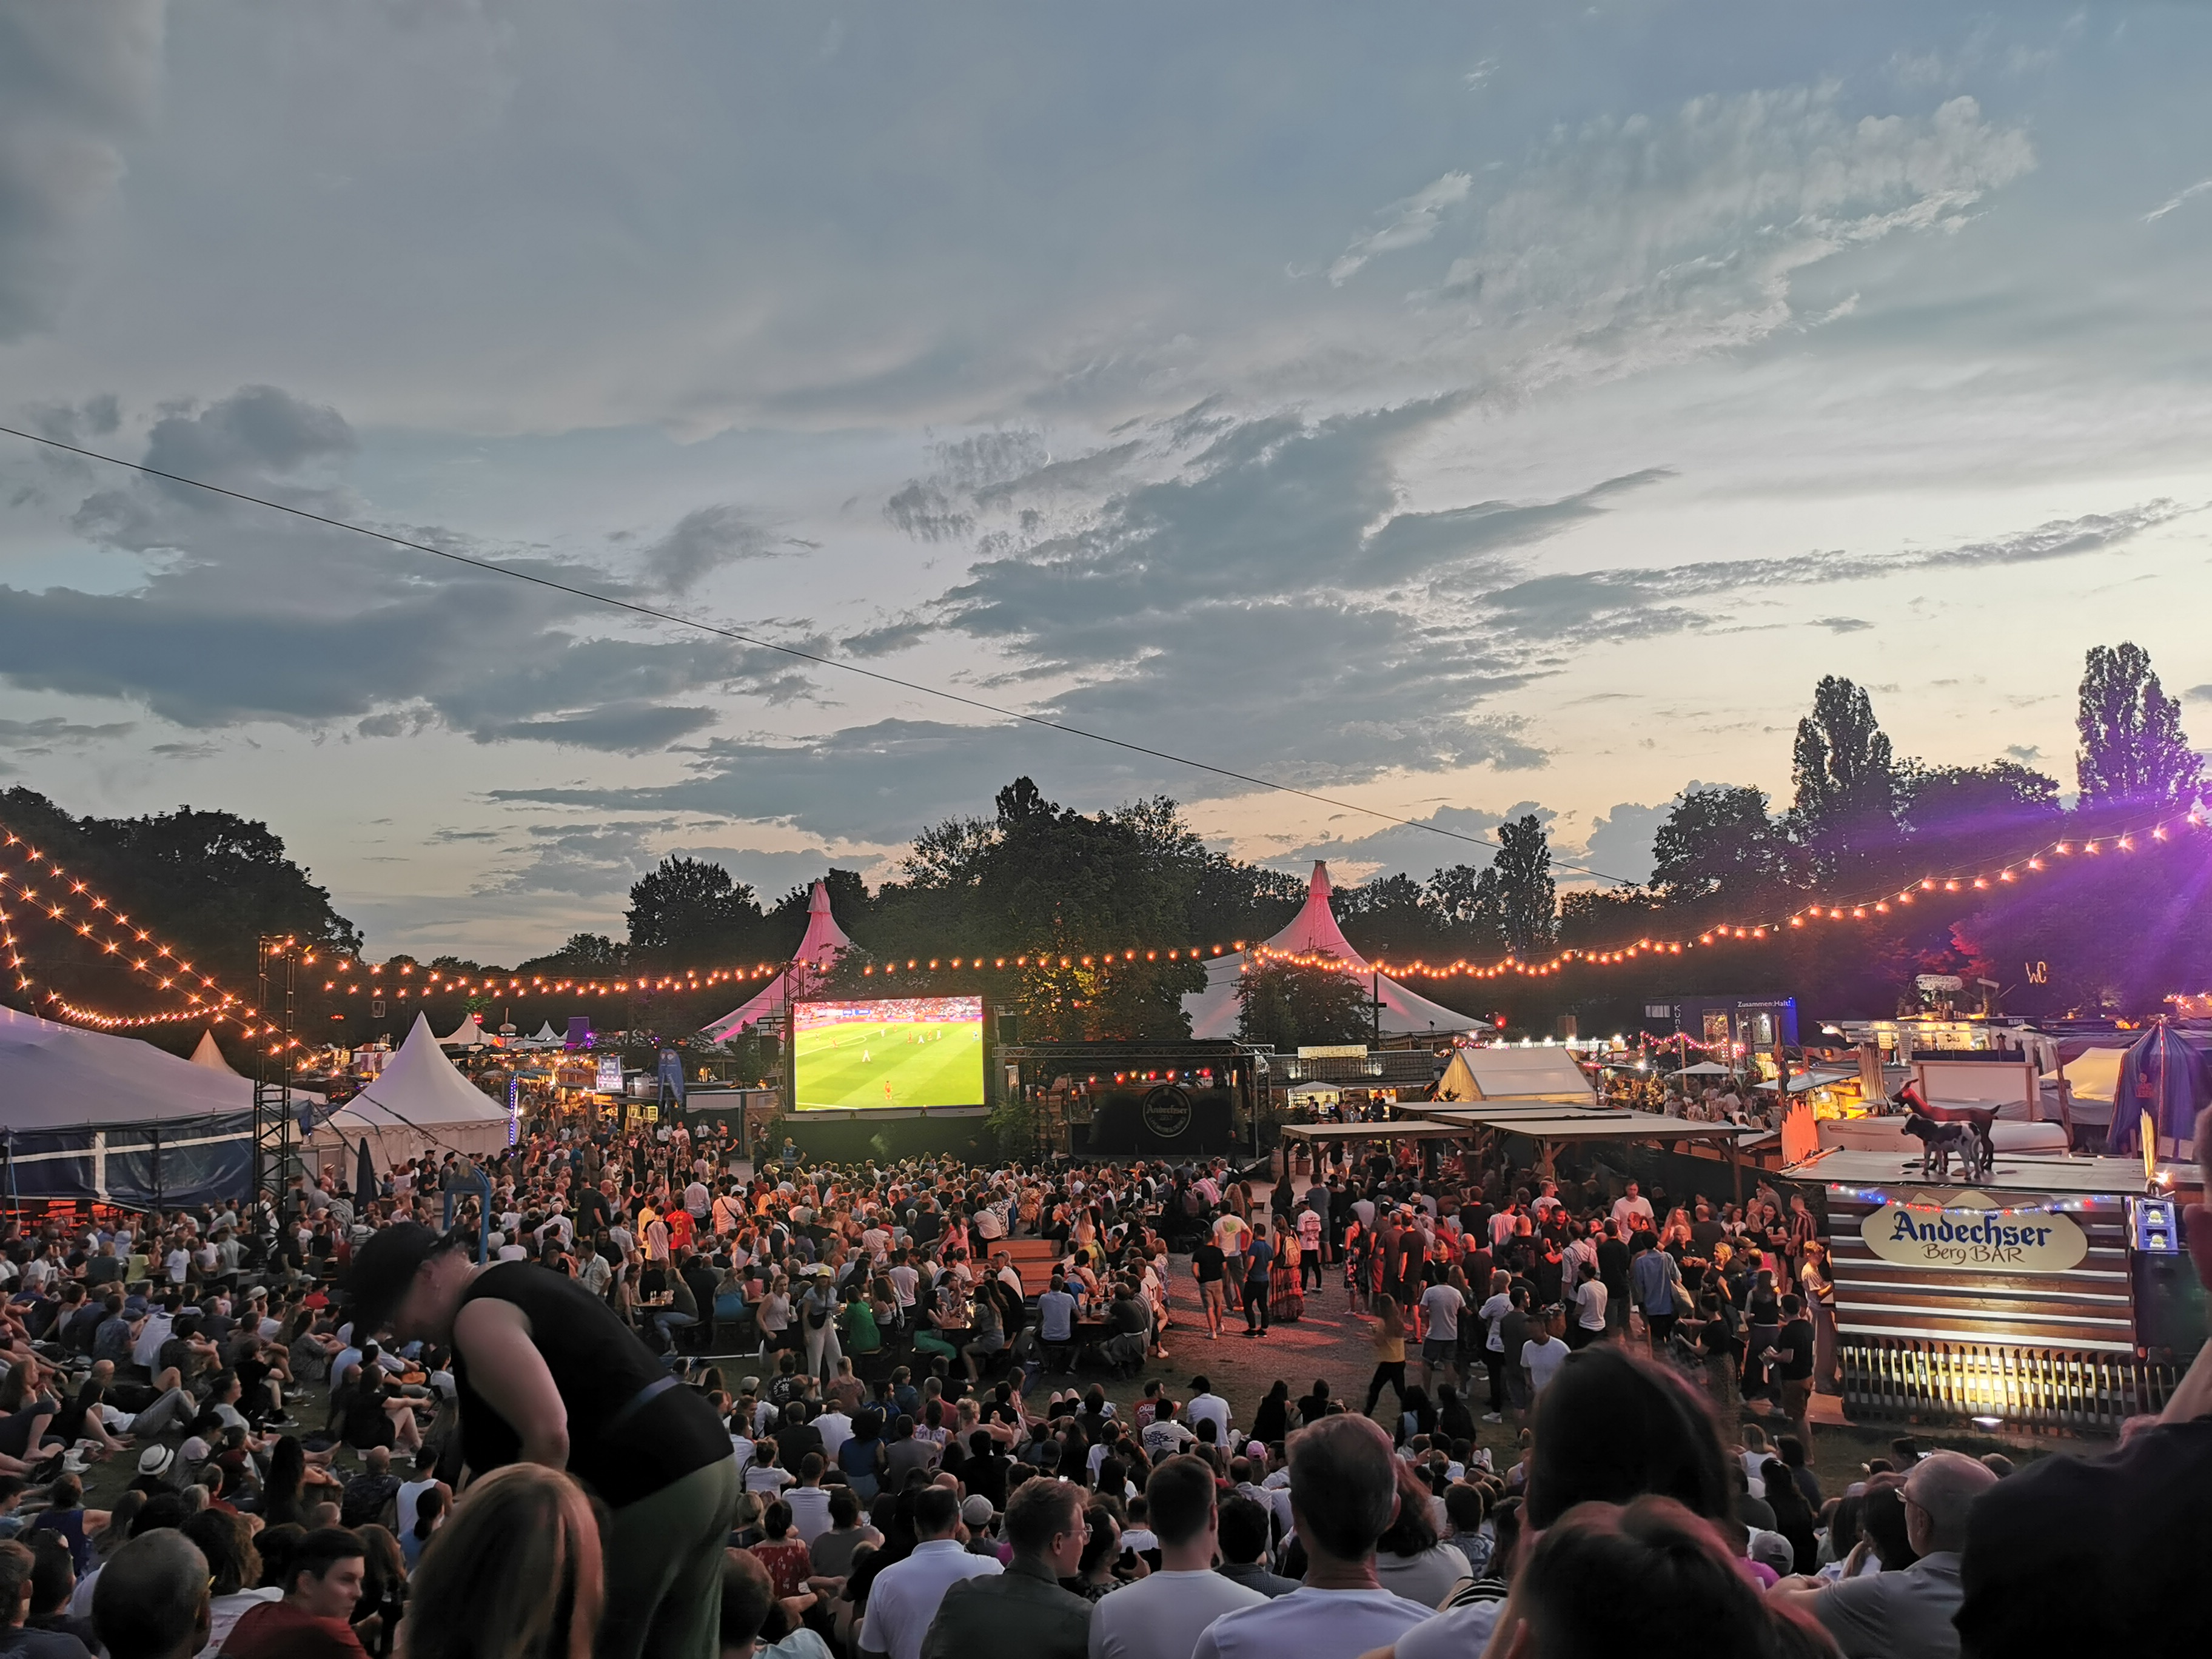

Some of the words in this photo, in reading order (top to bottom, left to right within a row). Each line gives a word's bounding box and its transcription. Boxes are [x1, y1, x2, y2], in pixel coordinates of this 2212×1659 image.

[2025, 961, 2046, 984] WC
[1945, 1033, 1961, 1043] Das
[1145, 1104, 1188, 1114] Andechser
[675, 1221, 683, 1236] 6
[1889, 1210, 2053, 1248] Andechser
[1921, 1243, 1966, 1265] Berg
[1969, 1244, 2026, 1263] BAR
